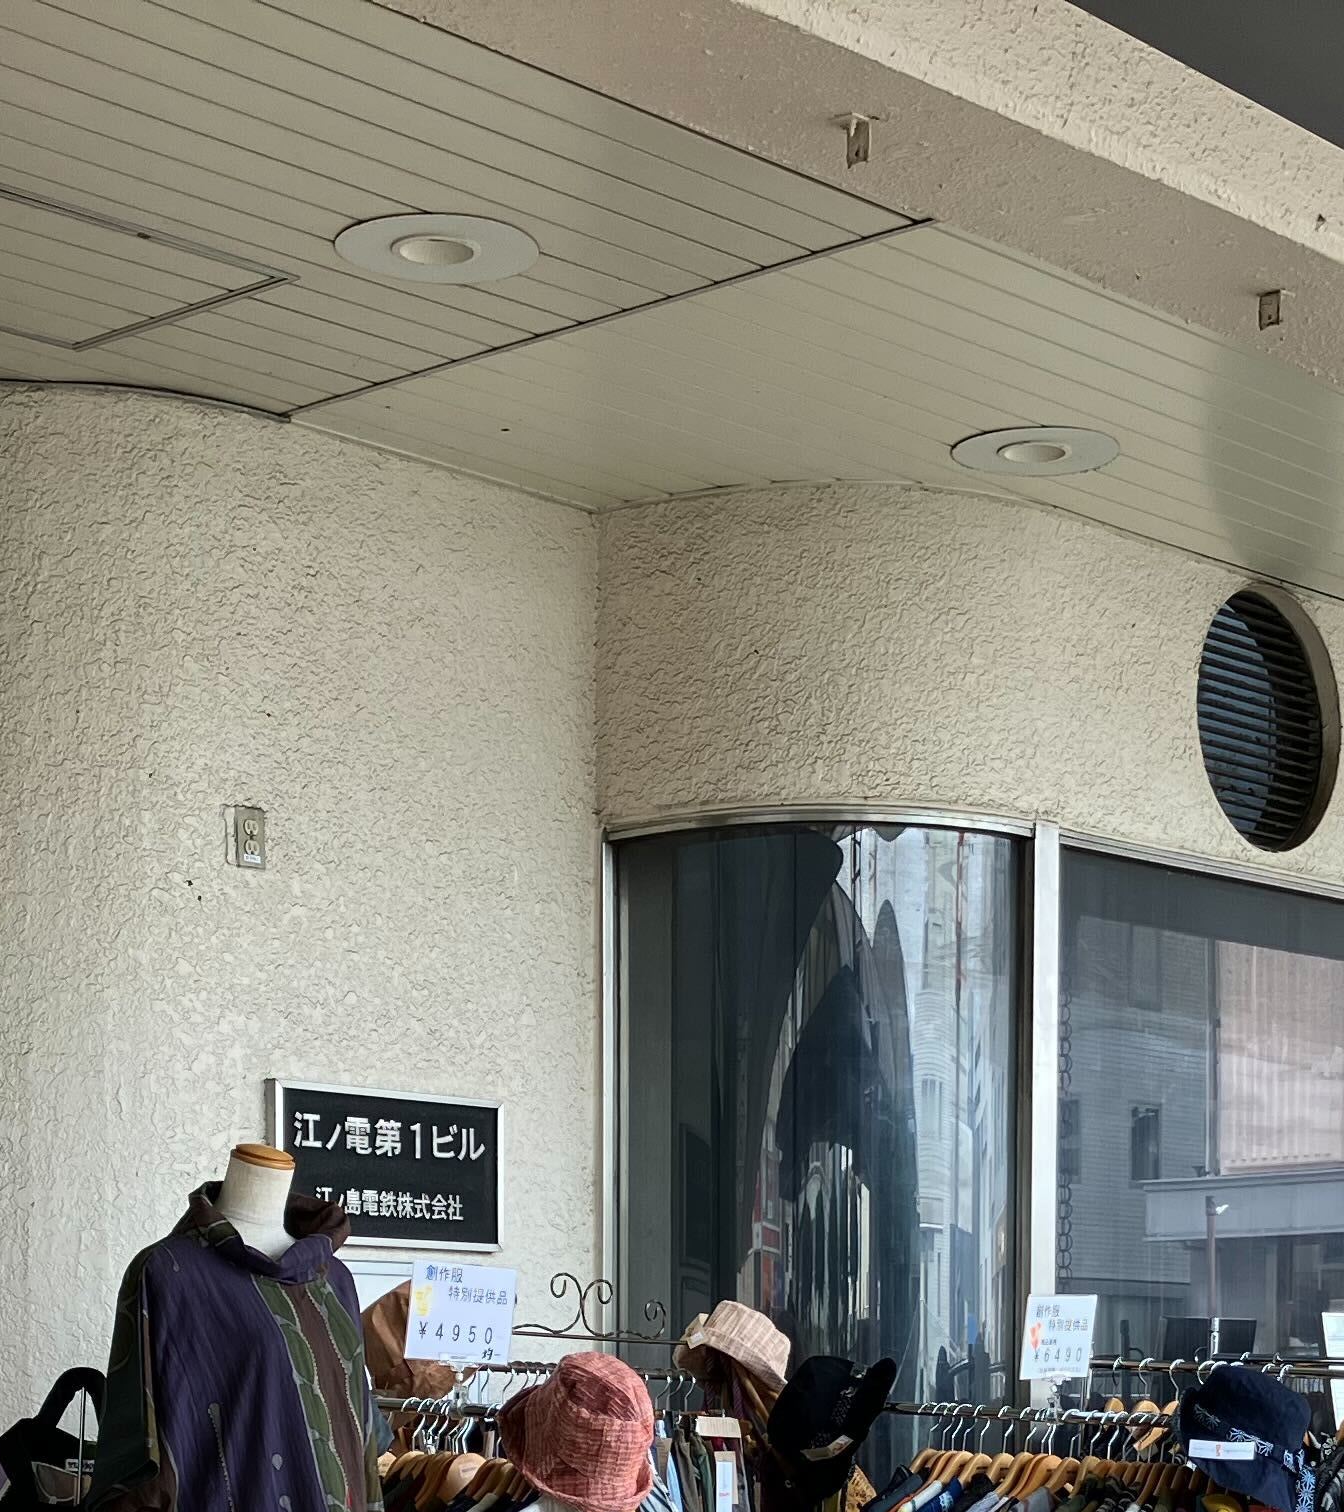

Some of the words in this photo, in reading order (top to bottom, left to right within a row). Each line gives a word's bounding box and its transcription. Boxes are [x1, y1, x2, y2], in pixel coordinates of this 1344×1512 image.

[293, 1111, 485, 1161] 江ノ電第1ビル
[426, 1265, 464, 1283] 創作服
[448, 1286, 508, 1305] 特別提供品
